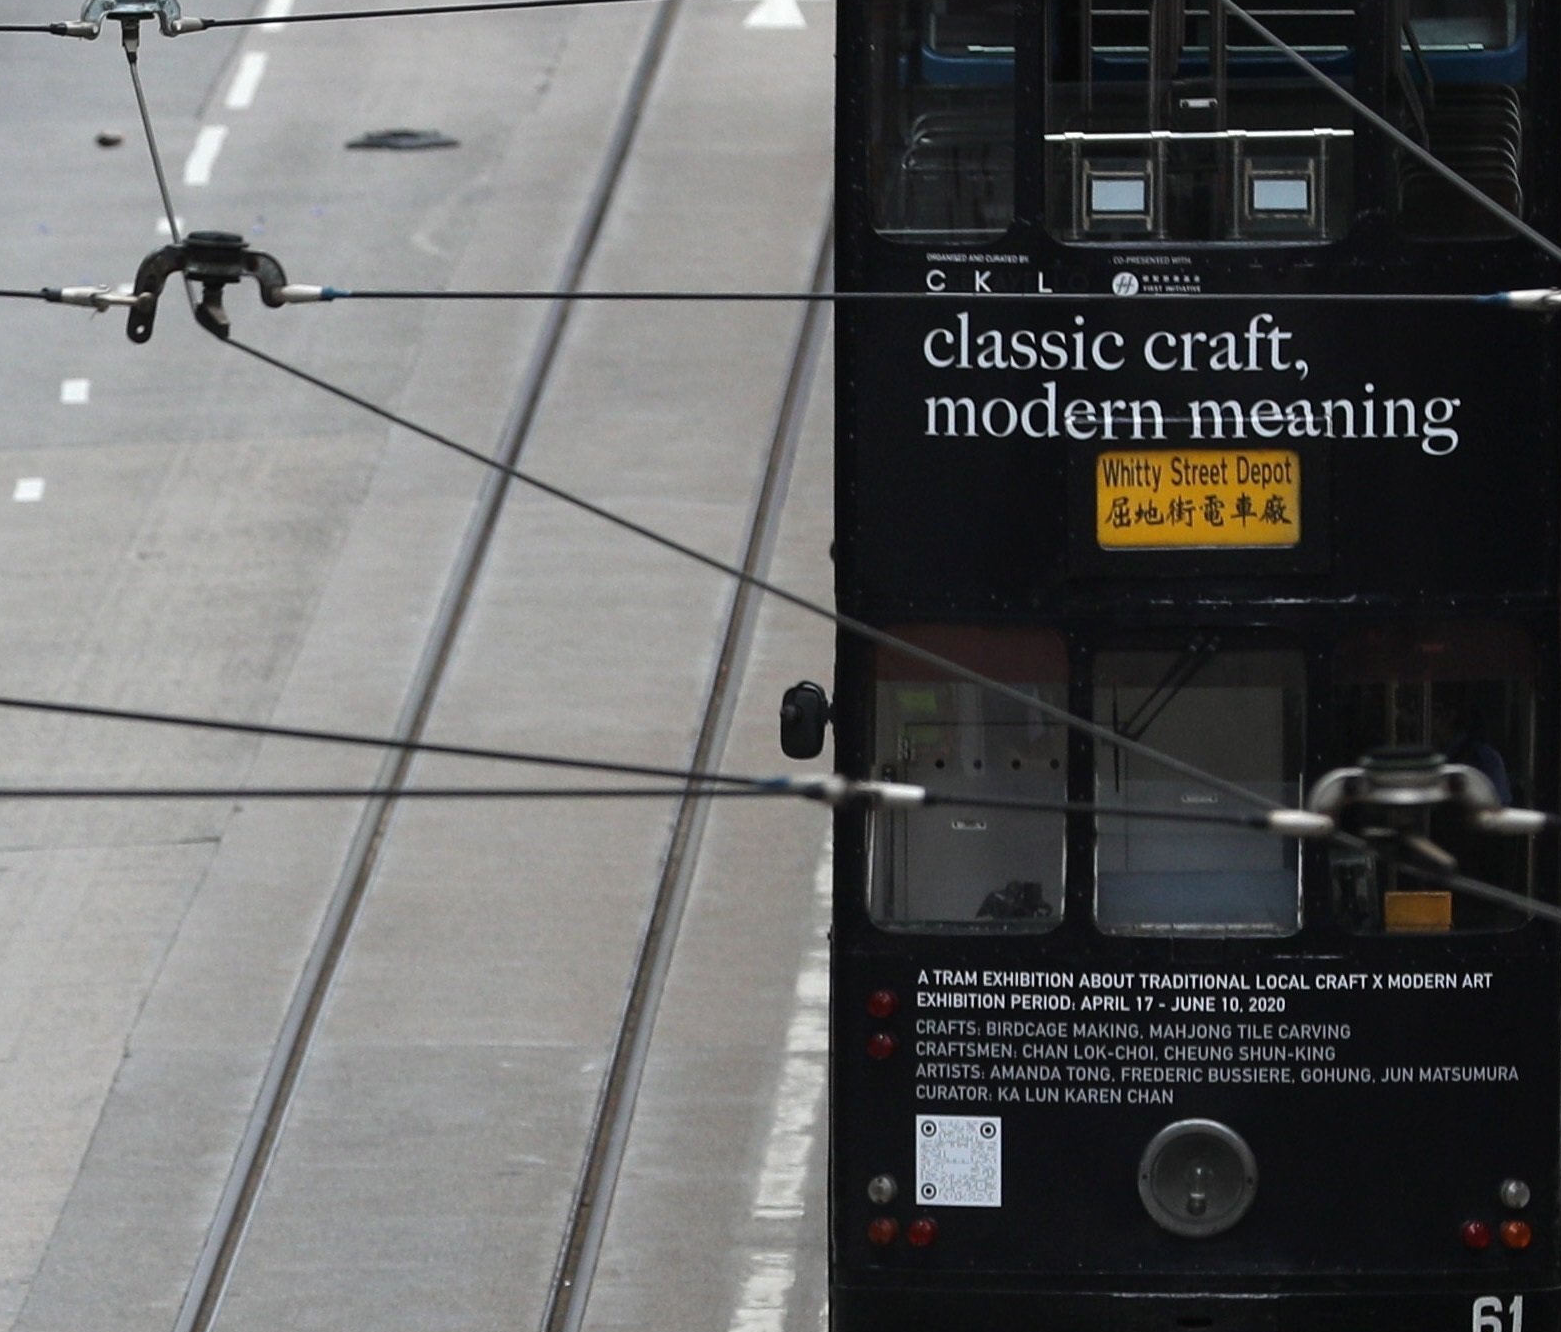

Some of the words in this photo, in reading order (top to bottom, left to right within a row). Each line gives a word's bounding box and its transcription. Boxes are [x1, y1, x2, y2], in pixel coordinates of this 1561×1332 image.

[923, 312, 1125, 370] classic
[1143, 313, 1309, 380] craft,
[924, 381, 1168, 441] modern
[1188, 383, 1461, 456] meaning
[1103, 456, 1162, 492] Whitty
[1171, 456, 1229, 486] Street
[1236, 457, 1293, 489] Depot
[1105, 494, 1294, 529] 屈地街電車廠
[918, 970, 929, 985] A
[933, 970, 977, 986] TRAM
[982, 971, 1074, 988] EXHIBITION
[1079, 973, 1135, 989] ABOUT
[1139, 974, 1251, 990] TRADITIONAL
[1256, 974, 1310, 990] LOCAL
[1315, 974, 1368, 990] CRAFT
[1372, 974, 1383, 990] X
[1388, 973, 1457, 989] MODERN
[1462, 972, 1493, 988] ART
[916, 992, 1005, 1009] EXHIBITION
[1010, 994, 1076, 1011] PERIOD:
[1080, 995, 1130, 1011] APRIL
[1136, 996, 1153, 1012] 17
[1171, 996, 1215, 1012] JUNE
[1248, 997, 1286, 1013] 2020
[915, 1019, 981, 1036] CRAFTS:
[986, 1021, 1068, 1037] BIRDCAGE
[1149, 1023, 1232, 1040] MAHJONG
[1237, 1024, 1273, 1040] TILE
[1278, 1024, 1351, 1040] CARVING
[915, 1041, 1018, 1058] CRAFTSMEN:
[1022, 1043, 1068, 1060] CHAN
[1163, 1045, 1234, 1062] CHEUNG
[1238, 1046, 1336, 1062] SHUN-KING
[915, 1063, 985, 1080] ARTISTS:
[989, 1065, 1062, 1081] AMANDA
[1120, 1067, 1203, 1083] FREDERIC
[1208, 1068, 1296, 1085] BUSSIERE,
[1300, 1067, 1376, 1085] GOHUNG,
[1381, 1067, 1414, 1083] JUN
[1418, 1065, 1519, 1082] MATSUMURA
[915, 1084, 994, 1102] CURATOR:
[997, 1086, 1020, 1102] KA
[1025, 1087, 1060, 1103] LUN
[1064, 1087, 1122, 1104] KAREN
[1127, 1088, 1174, 1104] CHAN
